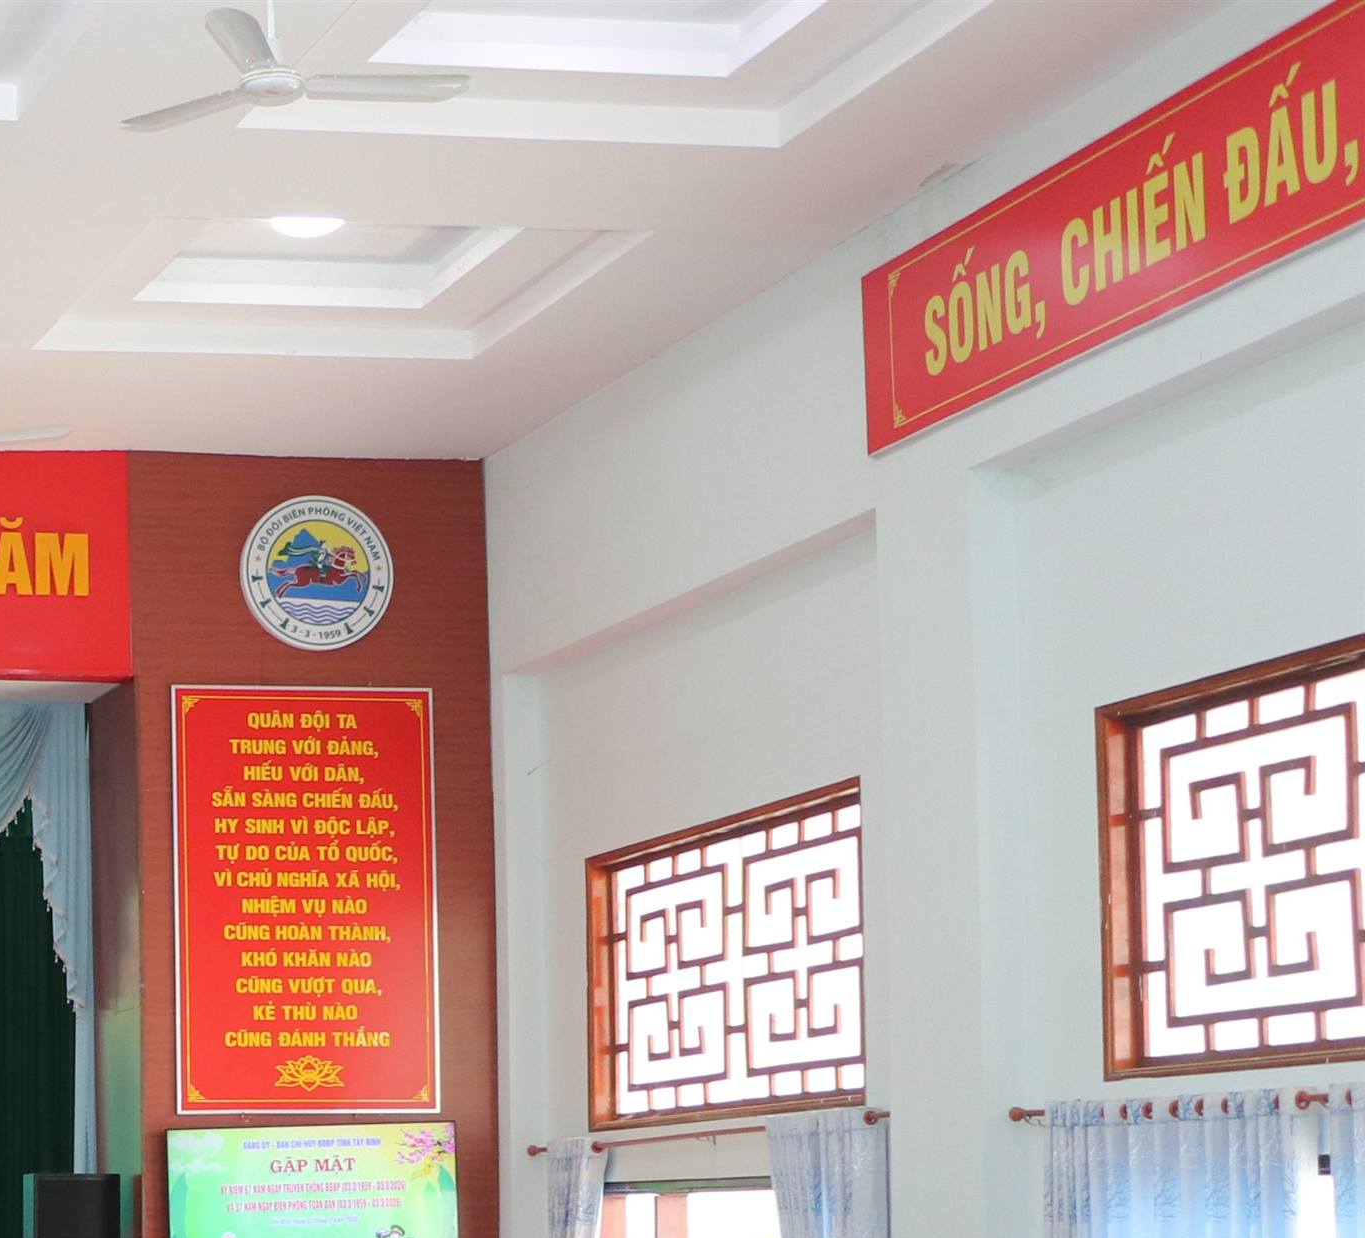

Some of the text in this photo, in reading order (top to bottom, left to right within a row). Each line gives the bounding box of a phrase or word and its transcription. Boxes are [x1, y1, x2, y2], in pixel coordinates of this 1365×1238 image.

[924, 62, 1360, 377] SỐNG, CHIẾN ĐẤU,
[248, 710, 357, 732] QUÂN ĐỘI TA
[229, 736, 378, 758] TRUNG VỚI ĐẢNG,
[244, 760, 364, 784] HIẾU VỚI DÂN,
[212, 786, 398, 811] SẴN SÀNG CHIẾN ĐẤU,
[215, 816, 394, 838] HY SINH VÌ ĐỘC LẬP,
[215, 840, 397, 864] TỰ DO CỦA TỔ QUỐC,
[214, 868, 400, 891] VÌ CHỦ NGHĨA XÃ HỘI,
[243, 896, 367, 917] NHIỆM VỤ NÀO
[224, 922, 391, 943] CŨNG HOÀN THÀNH,
[242, 948, 372, 967] KHÓ KHĂN NÀO
[236, 976, 382, 997] CŨNG VƯỢT QUA,
[253, 1001, 357, 1020] KẺ THÙ NÀO
[225, 1026, 390, 1047] CŨNG ĐÁNH THẮNG
[270, 1155, 356, 1177] GẶP MẶT
